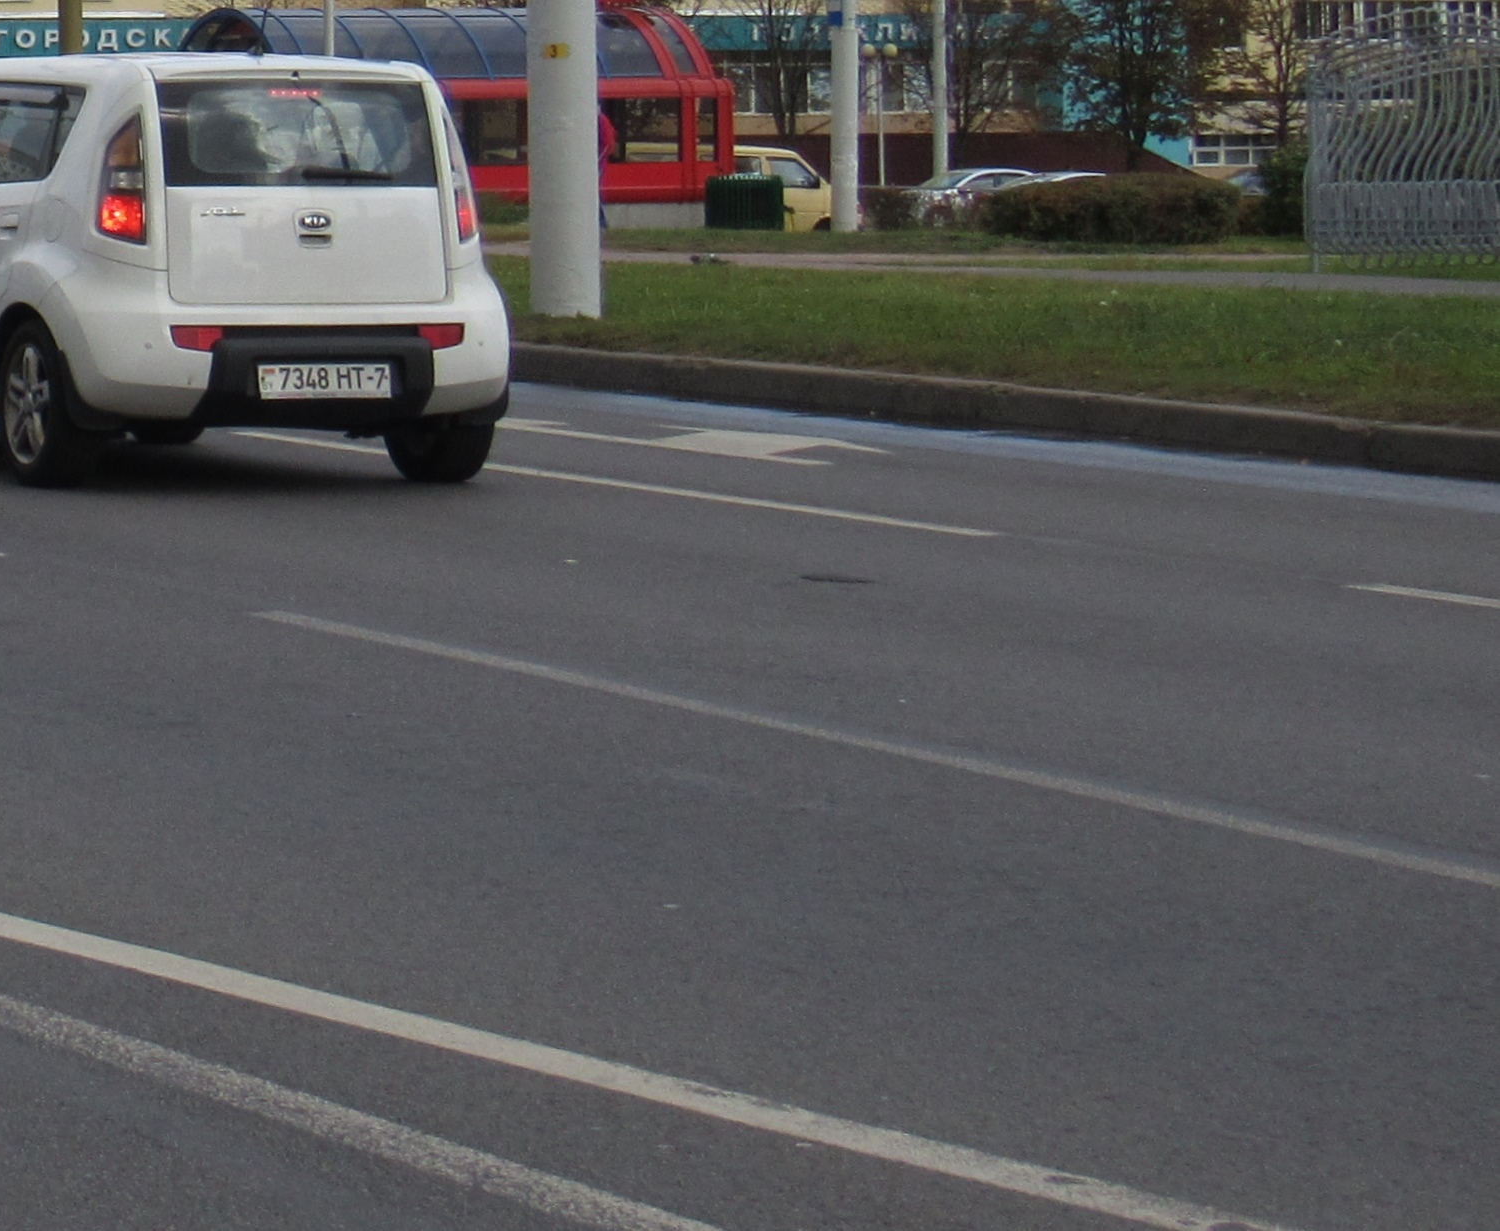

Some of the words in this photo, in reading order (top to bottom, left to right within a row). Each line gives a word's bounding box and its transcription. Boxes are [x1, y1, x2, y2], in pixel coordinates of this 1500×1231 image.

[549, 44, 557, 58] 3
[304, 216, 327, 224] KIA
[279, 367, 330, 390] 7348
[337, 367, 386, 390] HT-7
